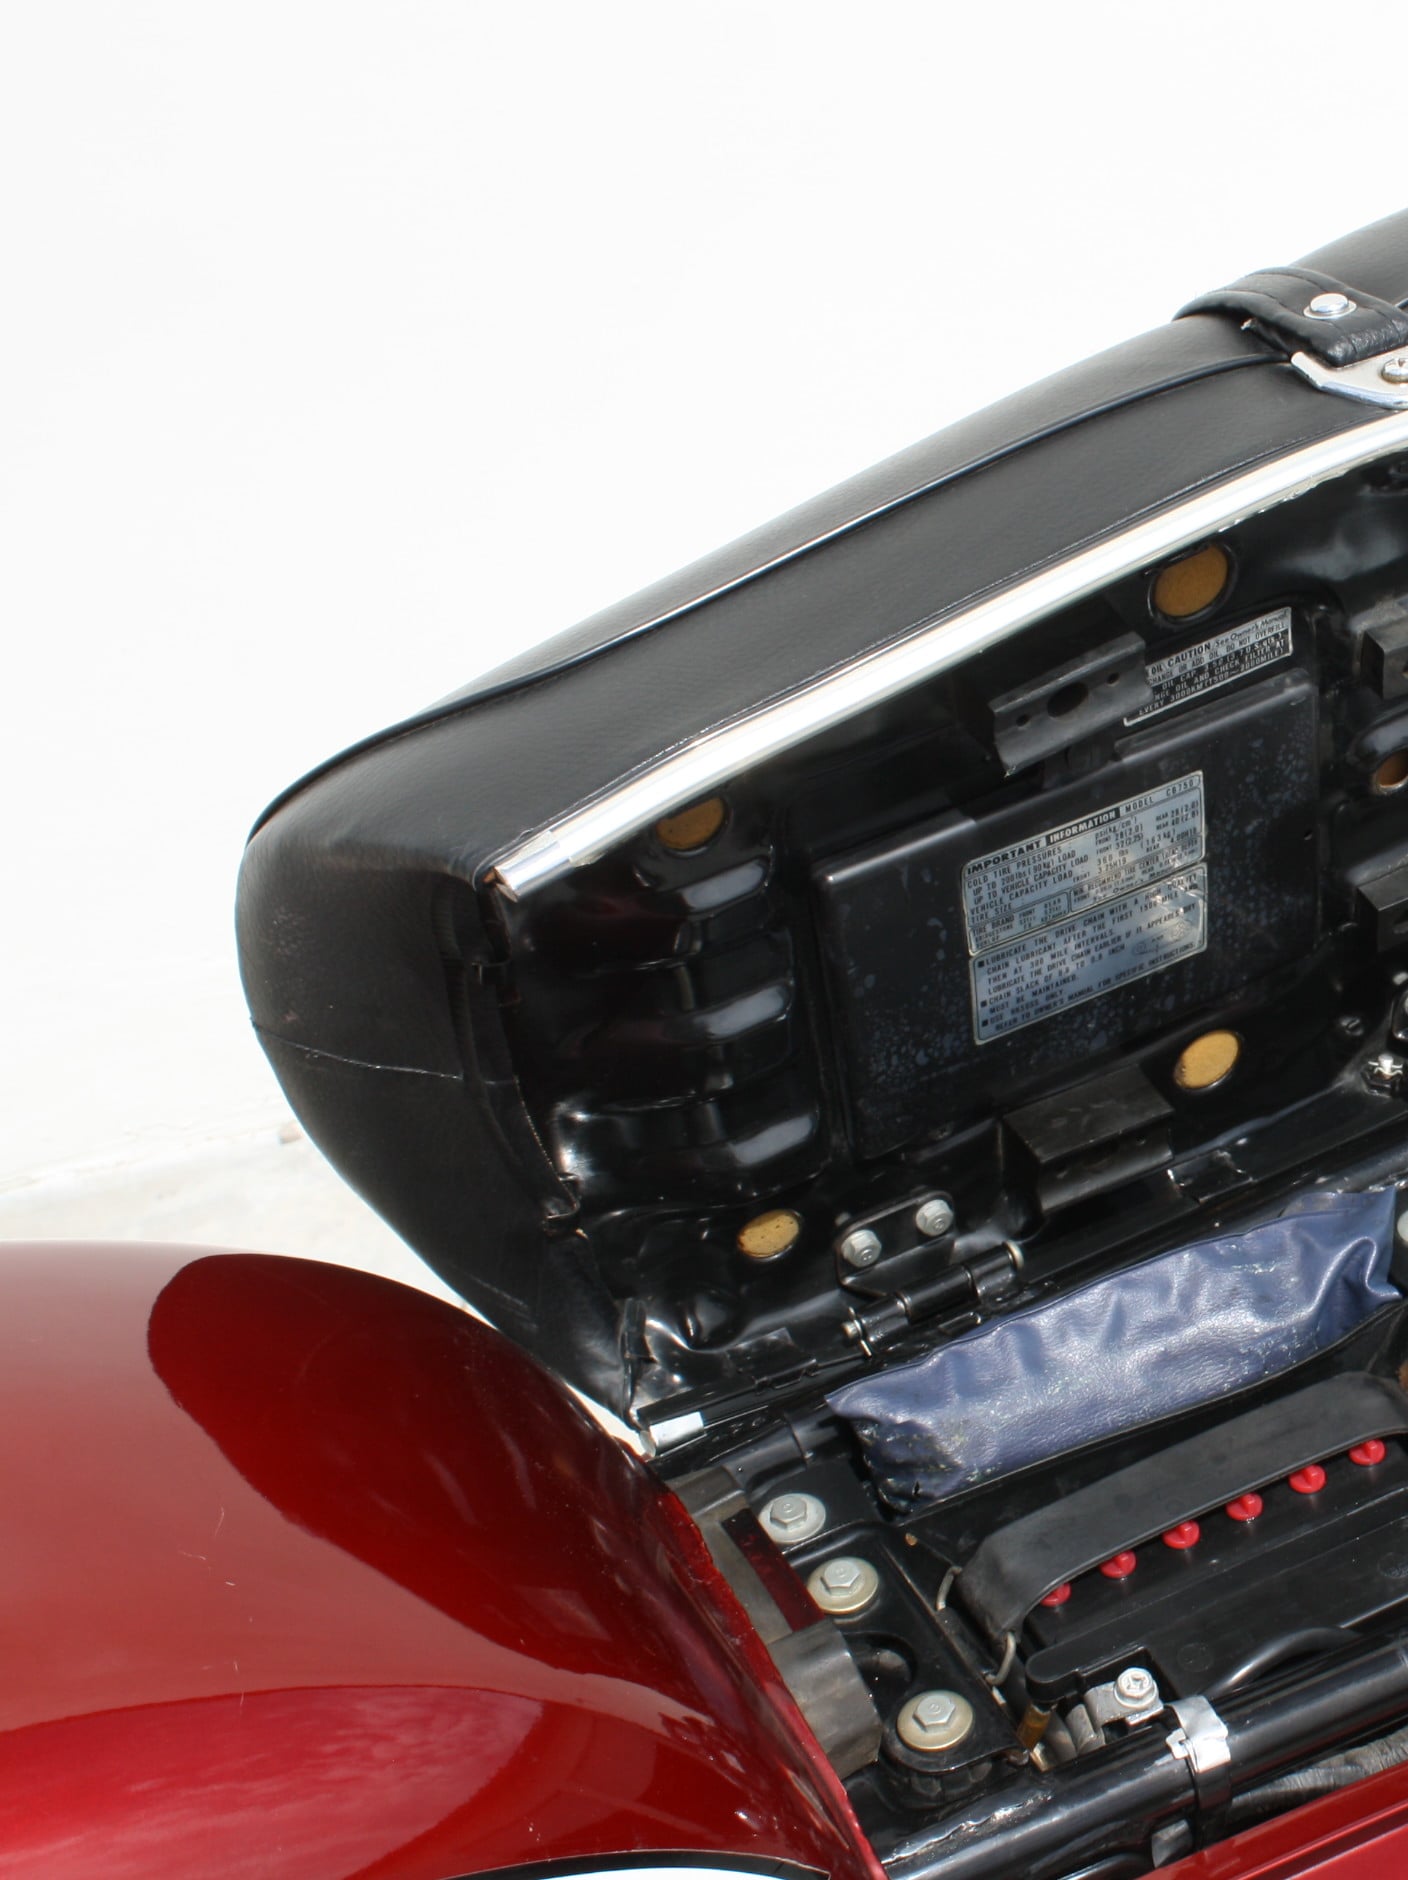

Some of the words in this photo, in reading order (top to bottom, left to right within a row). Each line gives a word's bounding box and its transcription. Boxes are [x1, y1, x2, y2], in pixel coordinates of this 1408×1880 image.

[1152, 664, 1163, 675] OIL
[1168, 643, 1210, 668] CAUTION
[1192, 656, 1204, 668] ADD
[1209, 650, 1219, 661] OIL
[1226, 642, 1235, 653] DO
[1239, 636, 1250, 647] NOT
[1256, 621, 1284, 640] OVERFILL
[1162, 680, 1173, 690] OIL
[1176, 682, 1187, 692] OIL
[1194, 672, 1209, 684] AND
[1215, 659, 1239, 675] CHECK
[1246, 645, 1271, 662] FILTER
[968, 839, 1041, 875] IMPORTANT
[1050, 810, 1116, 844] INFORMATION
[1125, 795, 1153, 813] MODEL
[1167, 779, 1194, 797] CB750
[968, 874, 989, 890] COLD
[994, 866, 1011, 879] TIRE
[1017, 845, 1062, 870] PRESSURES
[973, 887, 982, 897] UP
[987, 881, 996, 891] TO
[1058, 849, 1076, 863] LOAD
[974, 896, 983, 906] UP
[988, 891, 997, 900] TO
[1002, 878, 1029, 895] VEHICLE
[1034, 863, 1067, 882] CAPACITY
[1071, 854, 1088, 868] LOAD
[971, 898, 1003, 917] VEHICLE
[1009, 880, 1048, 901] CAPACITY
[1053, 870, 1073, 884] LOAD
[995, 903, 1011, 915] SIZE
[986, 943, 1026, 966] LUBRICATE
[1035, 934, 1048, 947] THE
[1055, 923, 1076, 938] DRIVE
[1084, 911, 1104, 927] CHAIN
[987, 961, 1010, 976] CHAIN
[1015, 941, 1056, 965] LUBRICANT
[1063, 929, 1087, 945] AFTER
[1112, 910, 1133, 925] FIRST
[988, 972, 1007, 986] THEN
[1014, 965, 1023, 975] AT
[1050, 947, 1068, 961] MILE
[988, 975, 1025, 996] LUBRICATE
[1031, 968, 1042, 979] THE
[1047, 958, 1066, 972] DRIVE
[1072, 948, 1091, 962] CHAIN
[989, 990, 1011, 1005] CHAIN
[1016, 979, 1039, 994] SLACK
[1044, 973, 1052, 983] OF
[990, 1001, 1009, 1015] MUST
[1016, 995, 1025, 1004] BE
